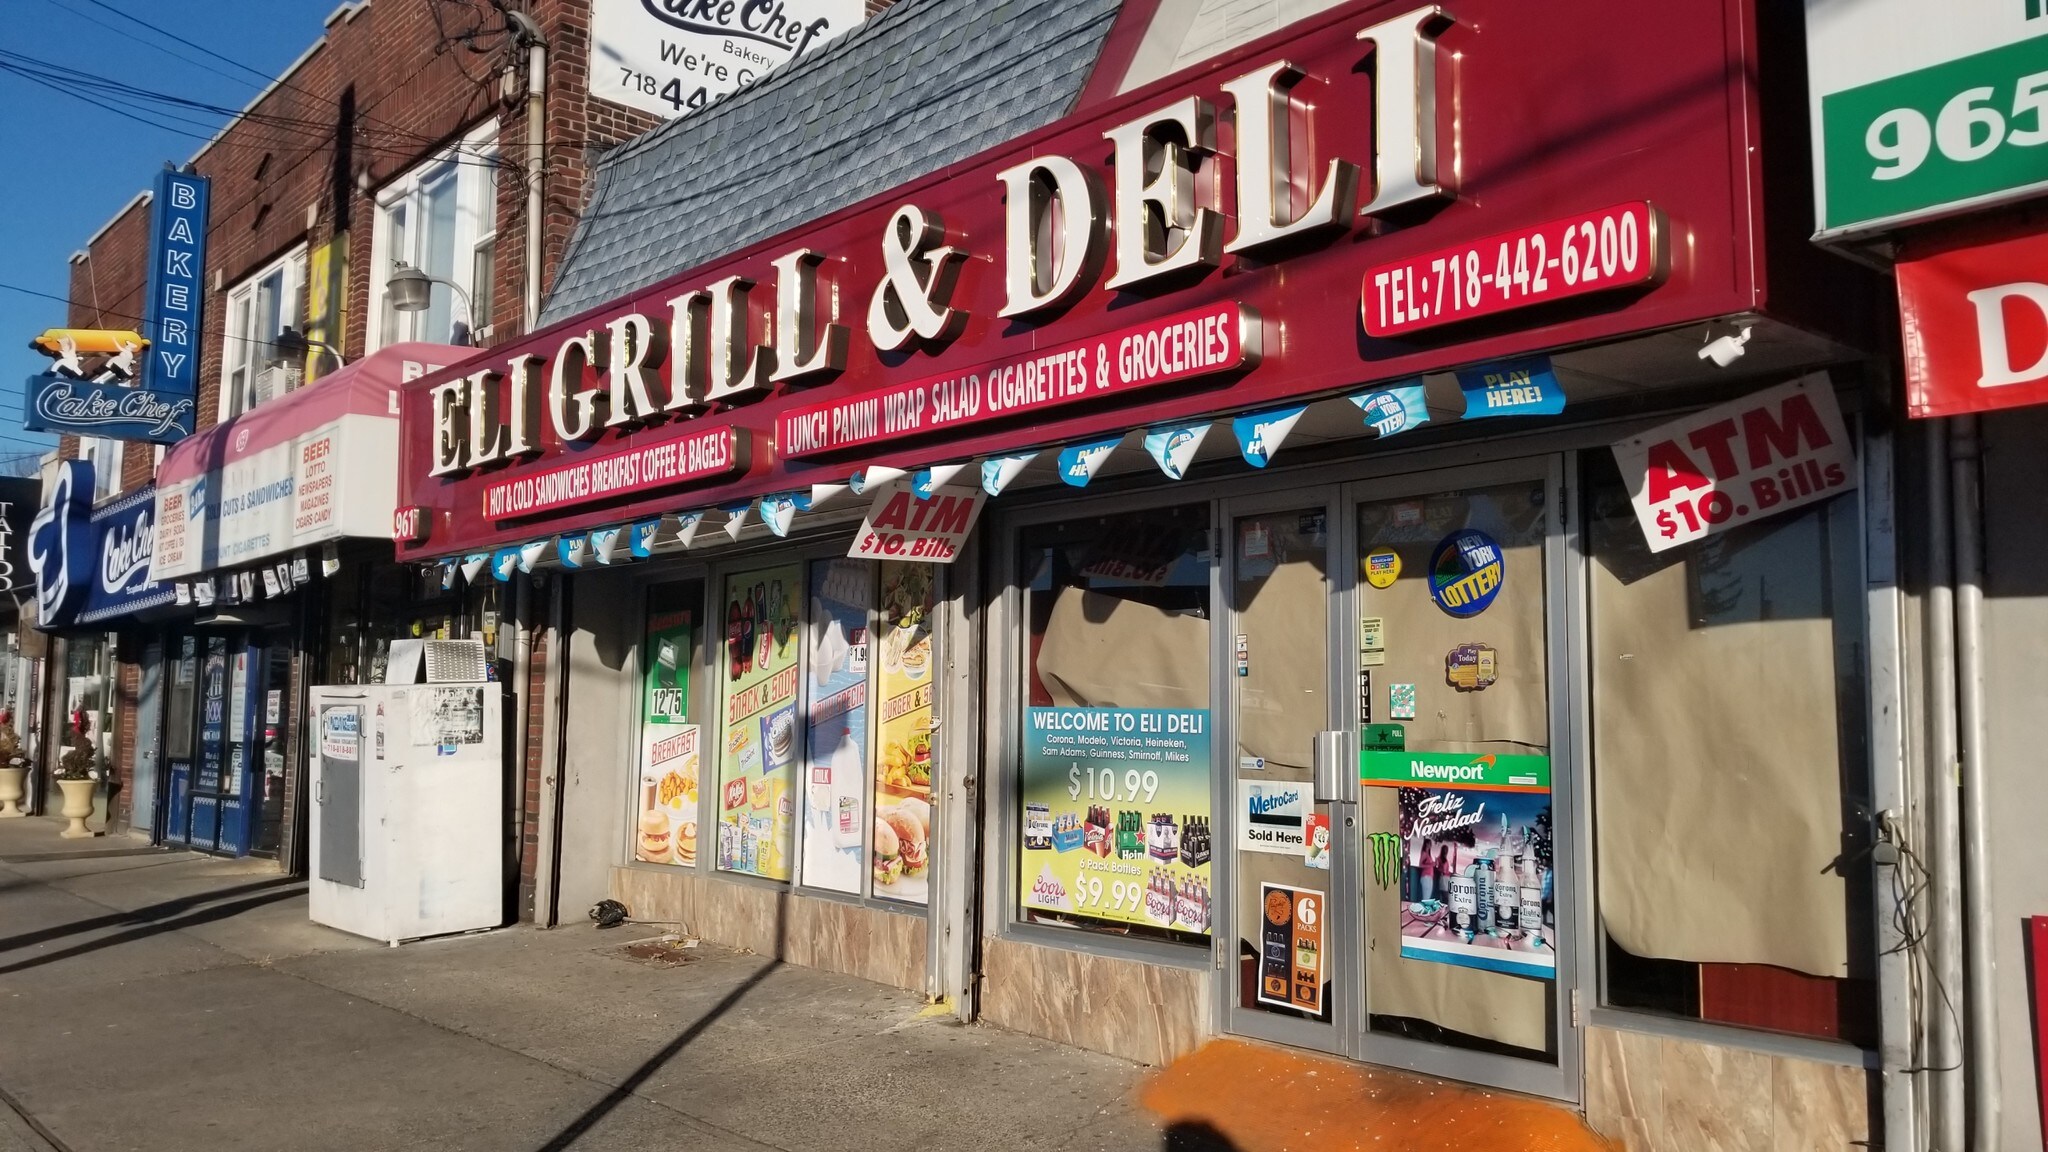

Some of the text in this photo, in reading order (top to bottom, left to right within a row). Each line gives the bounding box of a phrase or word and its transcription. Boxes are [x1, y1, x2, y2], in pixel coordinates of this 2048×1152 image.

[659, 39, 729, 82] We're
[722, 39, 775, 69] Bakery
[619, 67, 727, 112] 718 44
[429, 4, 1444, 479] ELI GRILL & DELI
[161, 182, 196, 378] BAKERY
[1375, 210, 1639, 328] TEL:718-442-6200
[787, 313, 1229, 453] LUNCH PANINI WRAP SALAD CIGARETTES & GROCERIES
[1484, 370, 1532, 389] PLAY
[36, 382, 193, 436] Cake Chef
[1376, 394, 1393, 407] NEW
[1380, 401, 1402, 416] YORK
[1486, 386, 1543, 408] HERE!
[303, 438, 330, 464] BEER
[1648, 393, 1833, 505] ATM
[306, 461, 326, 478] LOTTO
[490, 431, 727, 516] HOT & COLD SANDWICHES BREAKFAST COFFEE & BAGELS
[223, 497, 239, 517] CUTS
[247, 476, 293, 509] SANDWICHES
[298, 475, 332, 497] NEWSPAPERS
[1655, 458, 1847, 539] $10. Bills
[164, 493, 183, 512] BEER
[300, 492, 329, 512] MAGAZINES
[871, 490, 976, 534] ATM
[295, 508, 332, 530] CIGARS CANDY
[396, 516, 414, 537] 961
[860, 532, 954, 559] $10. Bills
[1456, 535, 1483, 552] NEW
[1462, 545, 1496, 570] YORK
[1439, 560, 1502, 608] LOTTERY
[1458, 654, 1477, 663] Today
[729, 664, 798, 723] SNACK & SODA
[882, 694, 912, 721] BURGER
[914, 690, 921, 707] &
[1361, 674, 1369, 719] PULL
[1033, 711, 1203, 735] WELCOME TO ELI DELI
[1391, 729, 1403, 738] PULL
[651, 731, 697, 762] BREAKFAST
[1042, 747, 1190, 763] Sam Adams, Guinness, Smirnoff, Mikes
[1046, 735, 1187, 750] Corona, Modelo, Victoria, Heineken,
[1068, 762, 1159, 804] $10.99
[1411, 760, 1484, 782] Newport
[1249, 790, 1299, 814] MetroCard
[1418, 792, 1465, 819] Feliz
[1404, 803, 1486, 841] Navidad
[1248, 829, 1303, 844] Sold Here
[1079, 860, 1142, 875] 6 Pack Bottles
[1032, 874, 1067, 897] Coors
[1075, 872, 1143, 913] $9.99
[1037, 894, 1060, 906] LIGHT
[1145, 892, 1171, 916] Coors
[1297, 897, 1317, 925] 6
[1478, 877, 1488, 921] Corona
[1175, 900, 1203, 924] Coors
[1297, 922, 1317, 932] PACKS
